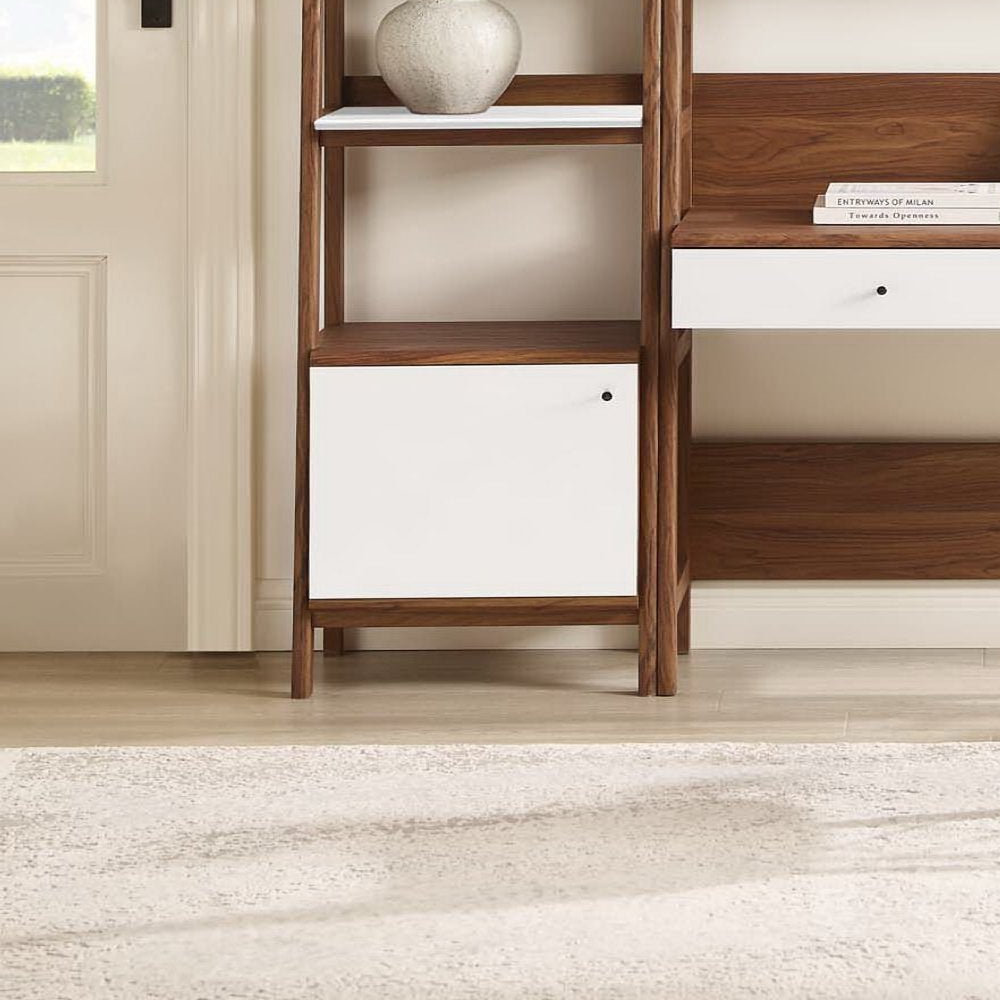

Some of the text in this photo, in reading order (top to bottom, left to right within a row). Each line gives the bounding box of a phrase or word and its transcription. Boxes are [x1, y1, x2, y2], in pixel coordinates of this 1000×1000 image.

[837, 198, 934, 206] ENTRYWAYS OF MILAN
[893, 212, 939, 220] Openness
